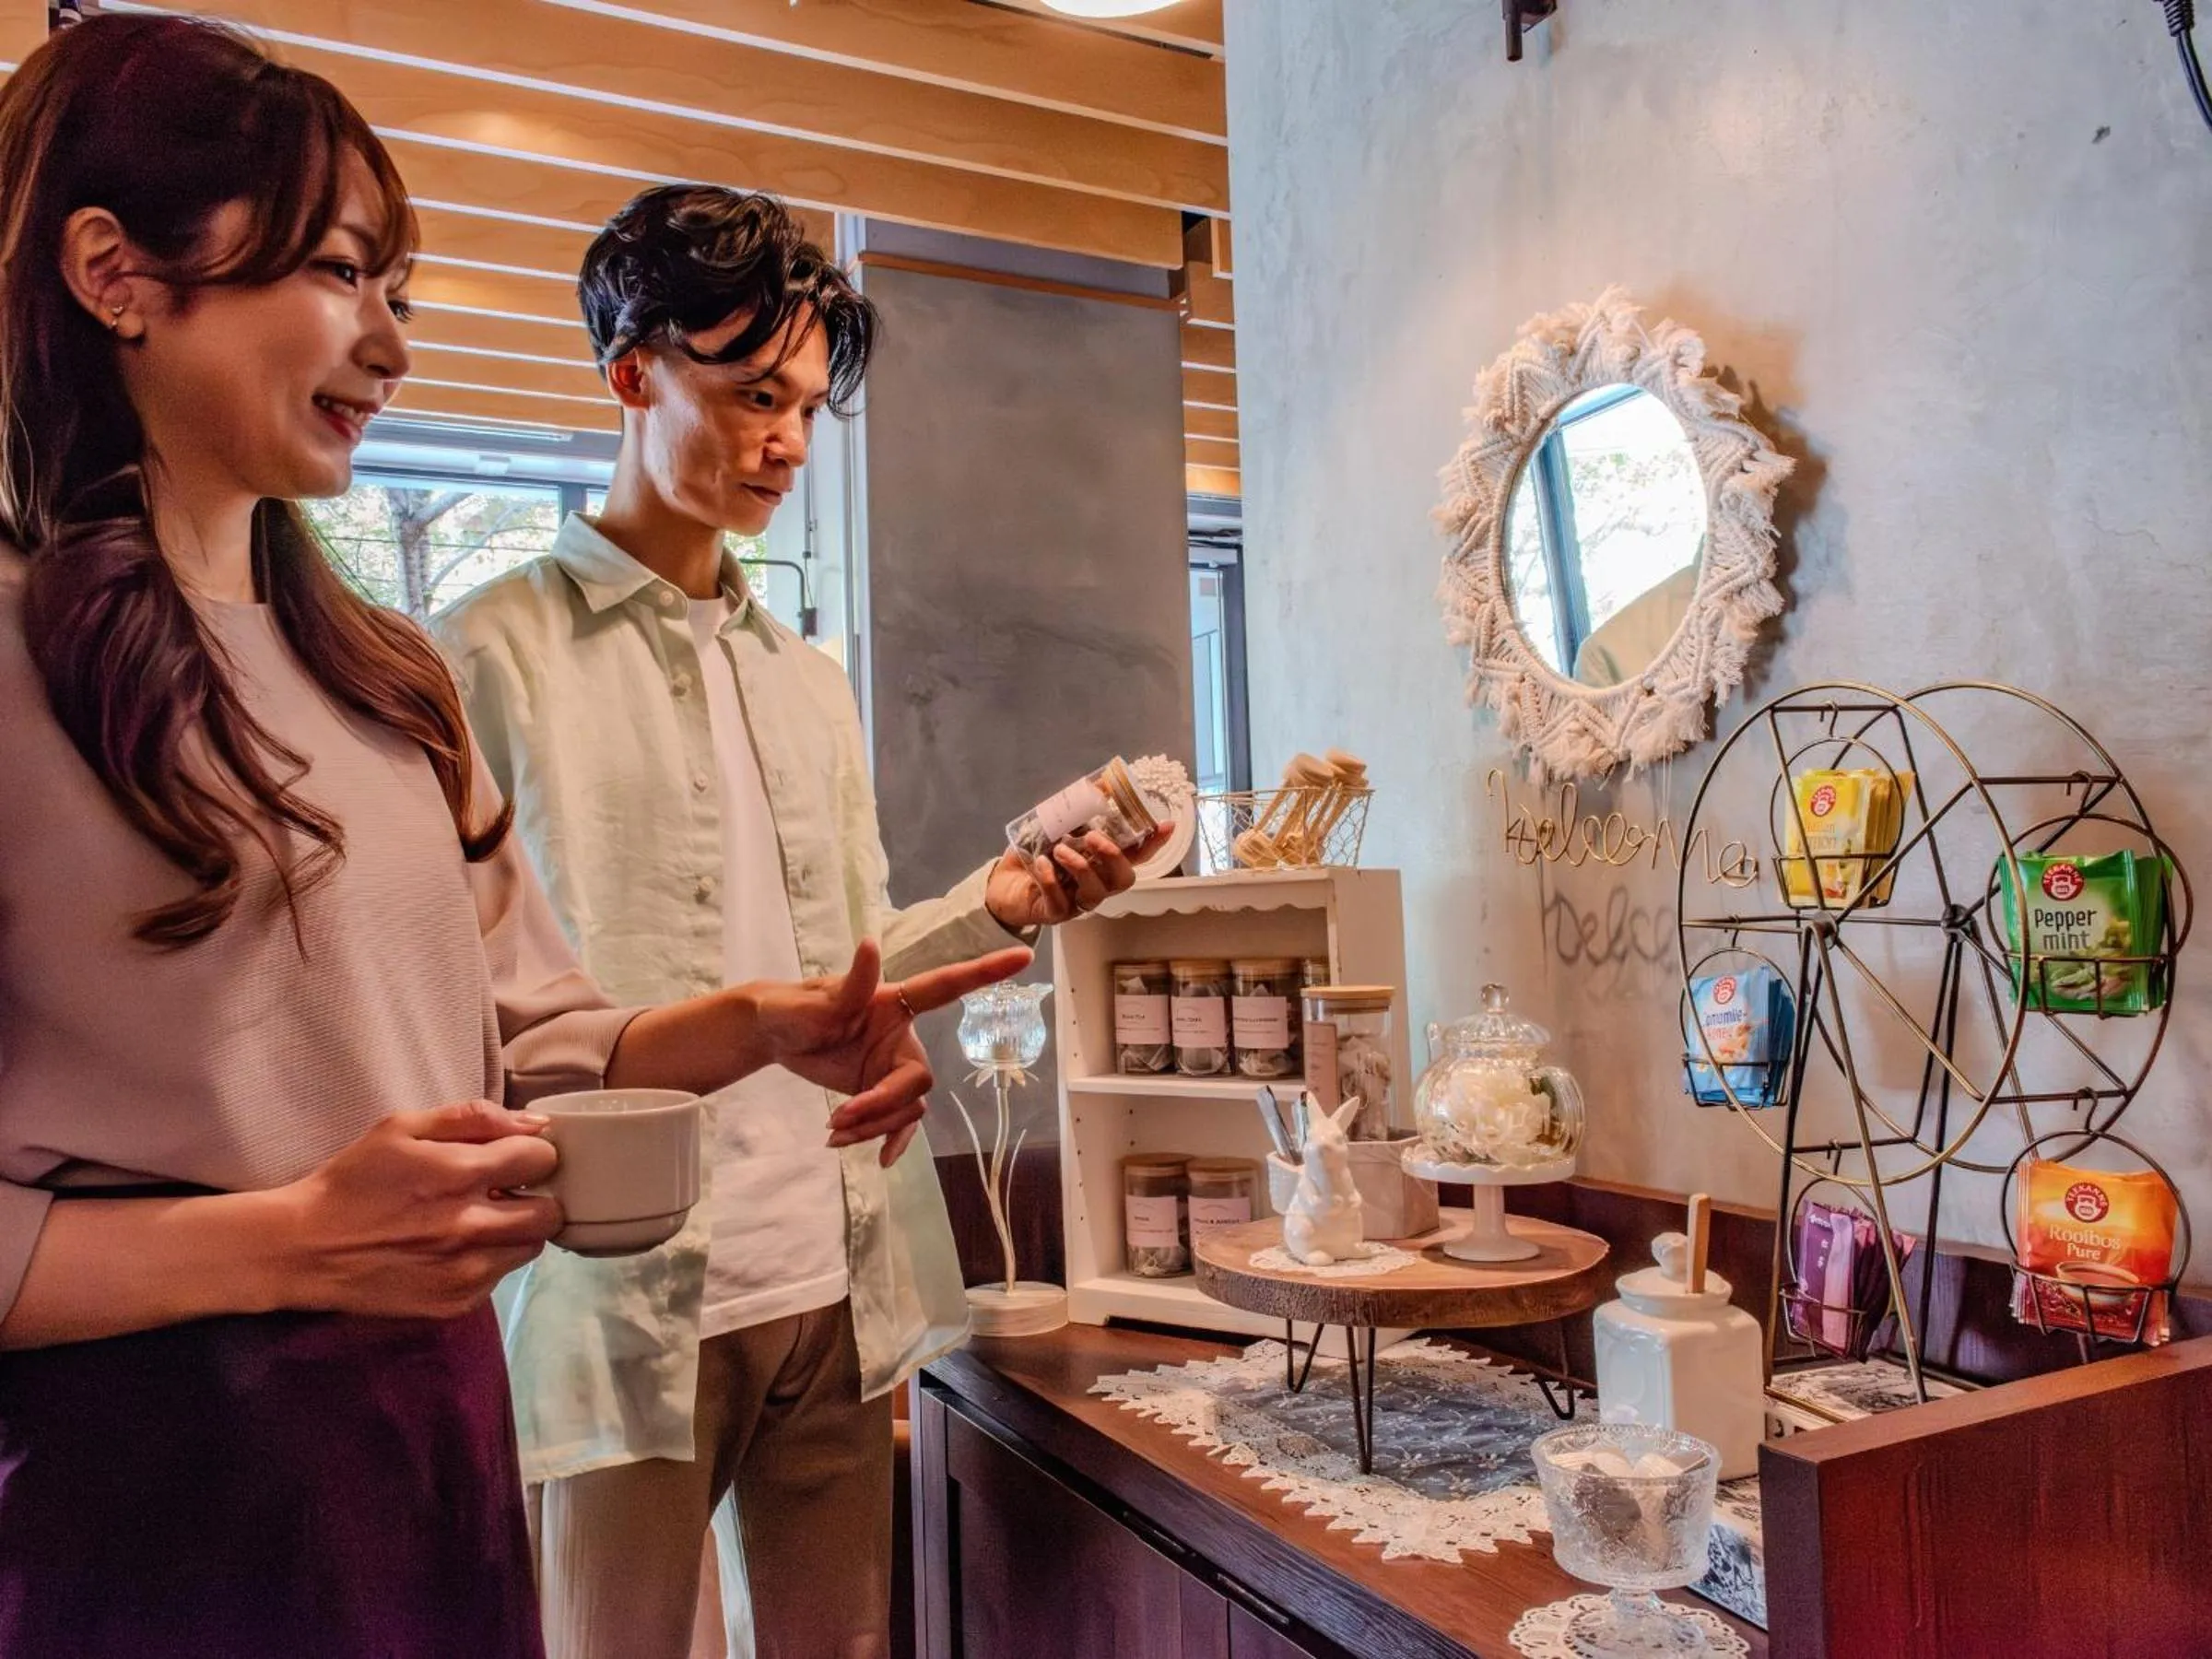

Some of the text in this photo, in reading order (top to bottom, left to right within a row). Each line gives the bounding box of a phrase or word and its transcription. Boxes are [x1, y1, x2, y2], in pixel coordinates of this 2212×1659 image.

[2034, 909, 2098, 932] Pepper
[2042, 931, 2091, 950] mint
[2049, 1223, 2122, 1250] Rooibos
[2066, 1243, 2101, 1260] Pure
